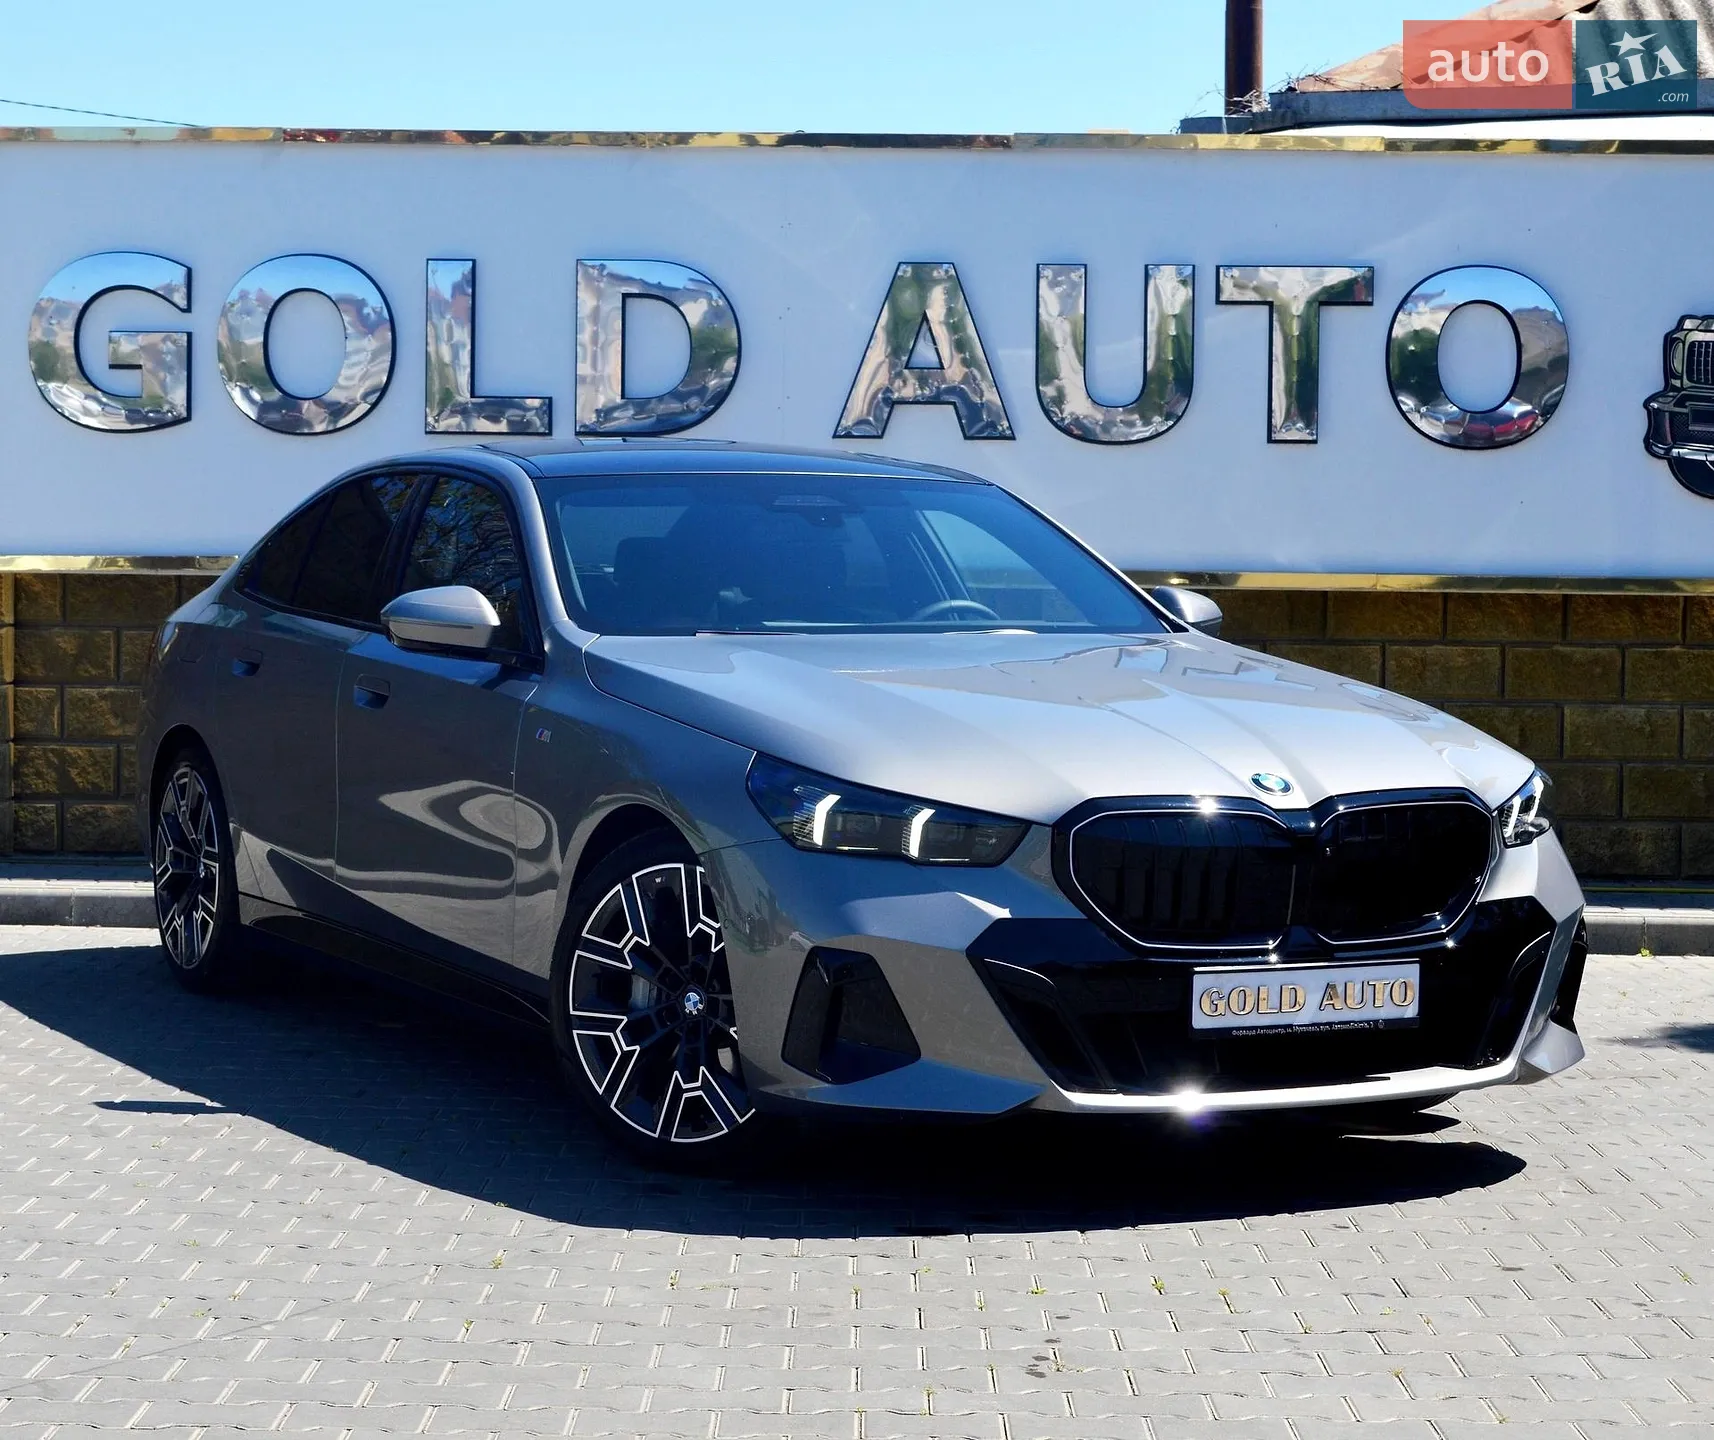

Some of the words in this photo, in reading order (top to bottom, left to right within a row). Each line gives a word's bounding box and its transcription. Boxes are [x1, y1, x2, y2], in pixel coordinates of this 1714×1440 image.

[28, 250, 743, 437] GOLD
[832, 261, 1570, 449] AUTO
[1199, 984, 1307, 1017] GOLD
[1319, 977, 1416, 1012] AUTO
